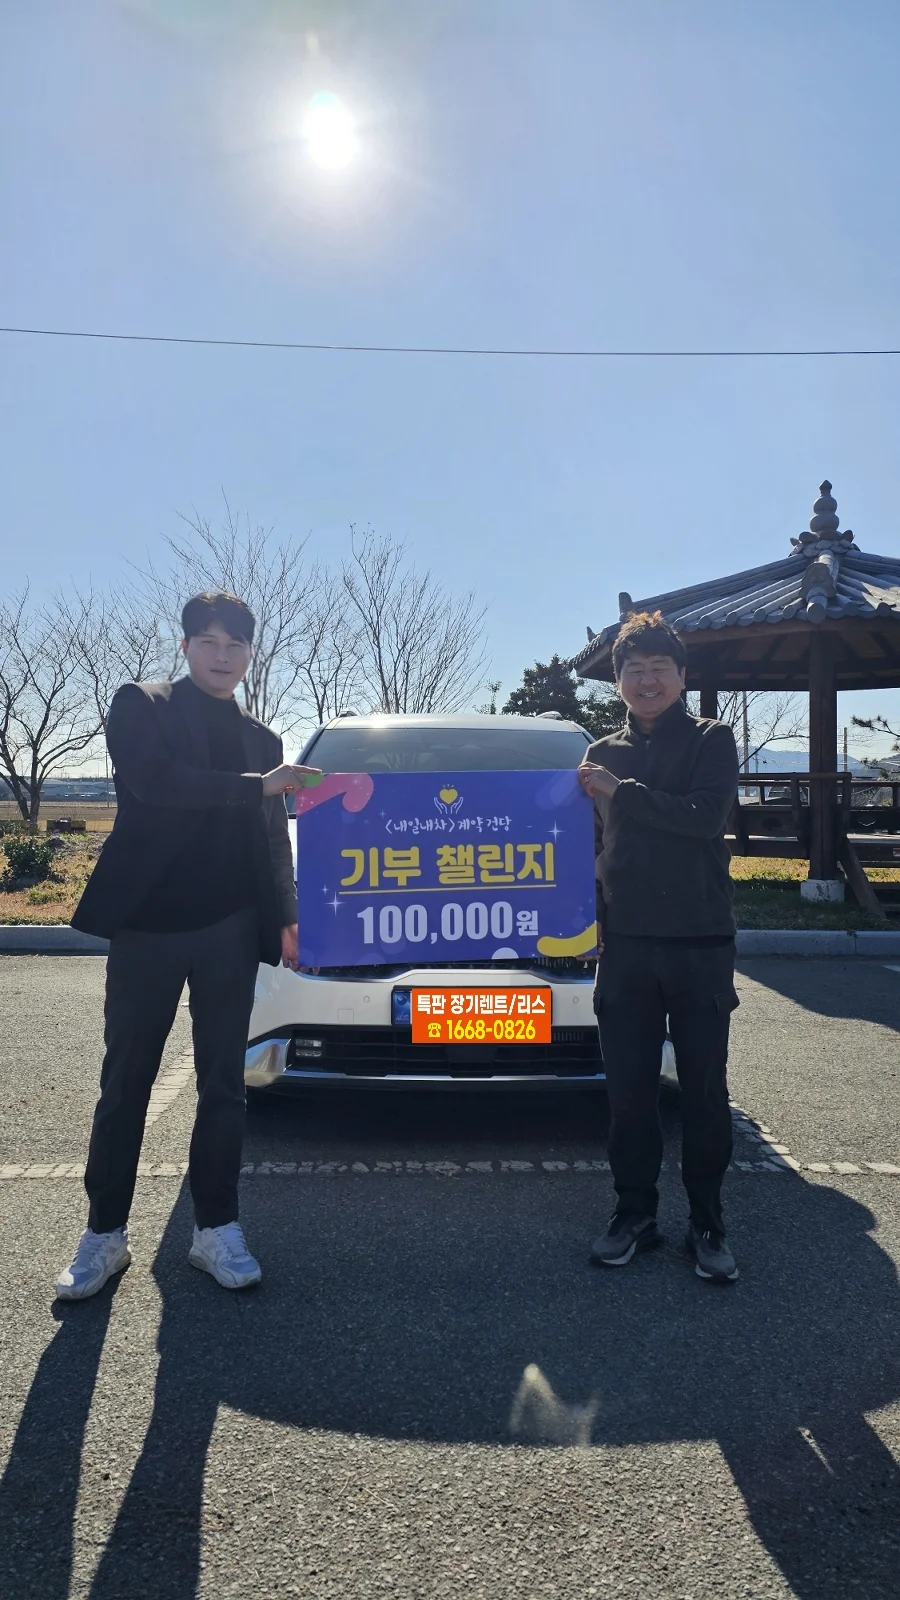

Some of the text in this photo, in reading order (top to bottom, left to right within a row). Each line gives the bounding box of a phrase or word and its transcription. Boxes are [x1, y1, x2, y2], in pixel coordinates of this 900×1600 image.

[457, 816, 484, 833] 계약
[486, 815, 512, 832] 건당
[340, 842, 555, 887] 기부 챌린지
[357, 901, 539, 945] 100,000원
